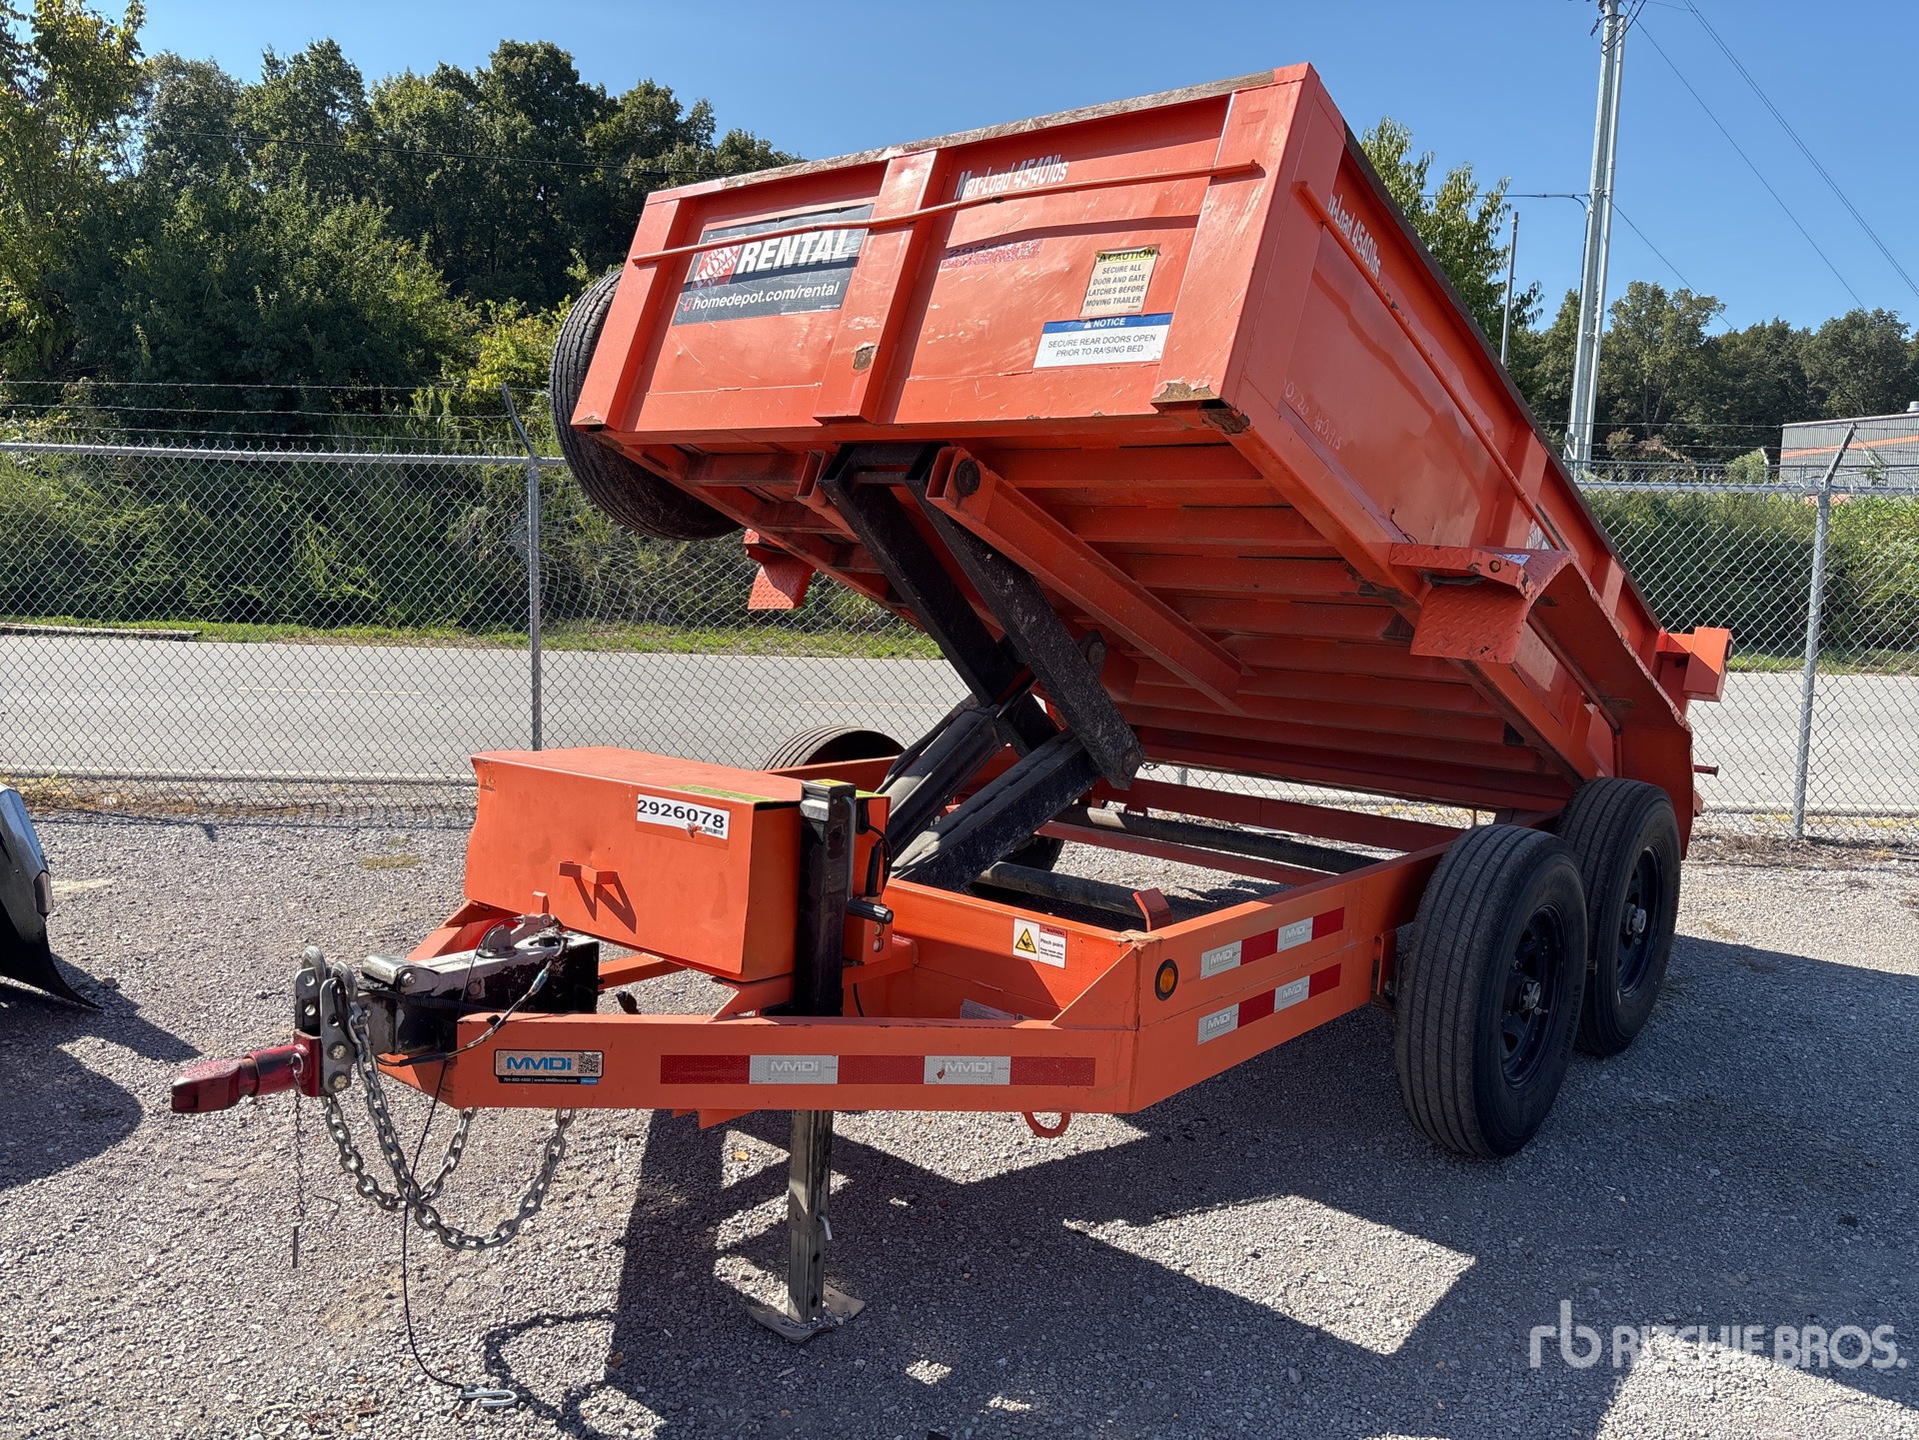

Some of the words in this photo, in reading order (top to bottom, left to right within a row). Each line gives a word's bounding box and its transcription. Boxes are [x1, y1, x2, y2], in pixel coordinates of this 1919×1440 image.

[954, 162, 1015, 199] Max-Load
[1012, 154, 1069, 189] 4540lbs
[735, 228, 851, 275] RENTAL
[1107, 249, 1156, 262] CAUTION
[1102, 264, 1128, 275] SECURE
[1129, 263, 1142, 272] ALL
[1092, 277, 1112, 286] DOOR
[1128, 274, 1146, 283] GATE
[692, 281, 840, 311] homedepot.com/rental
[1088, 286, 1117, 297] LATCHES
[1118, 285, 1145, 294] BEFORE
[1085, 297, 1111, 307] MOVING
[1112, 295, 1141, 305] TRAILER
[1093, 317, 1126, 328] NOTICE
[1048, 339, 1079, 349] SECURE
[1079, 337, 1101, 346] REAR
[1102, 334, 1131, 345] DOORS
[1132, 333, 1157, 342] OPEN
[1056, 347, 1081, 357] PRIOR
[1082, 346, 1093, 355] TO
[1126, 344, 1144, 353] BED
[637, 799, 725, 829] 2926078
[506, 1056, 572, 1070] MMDi
